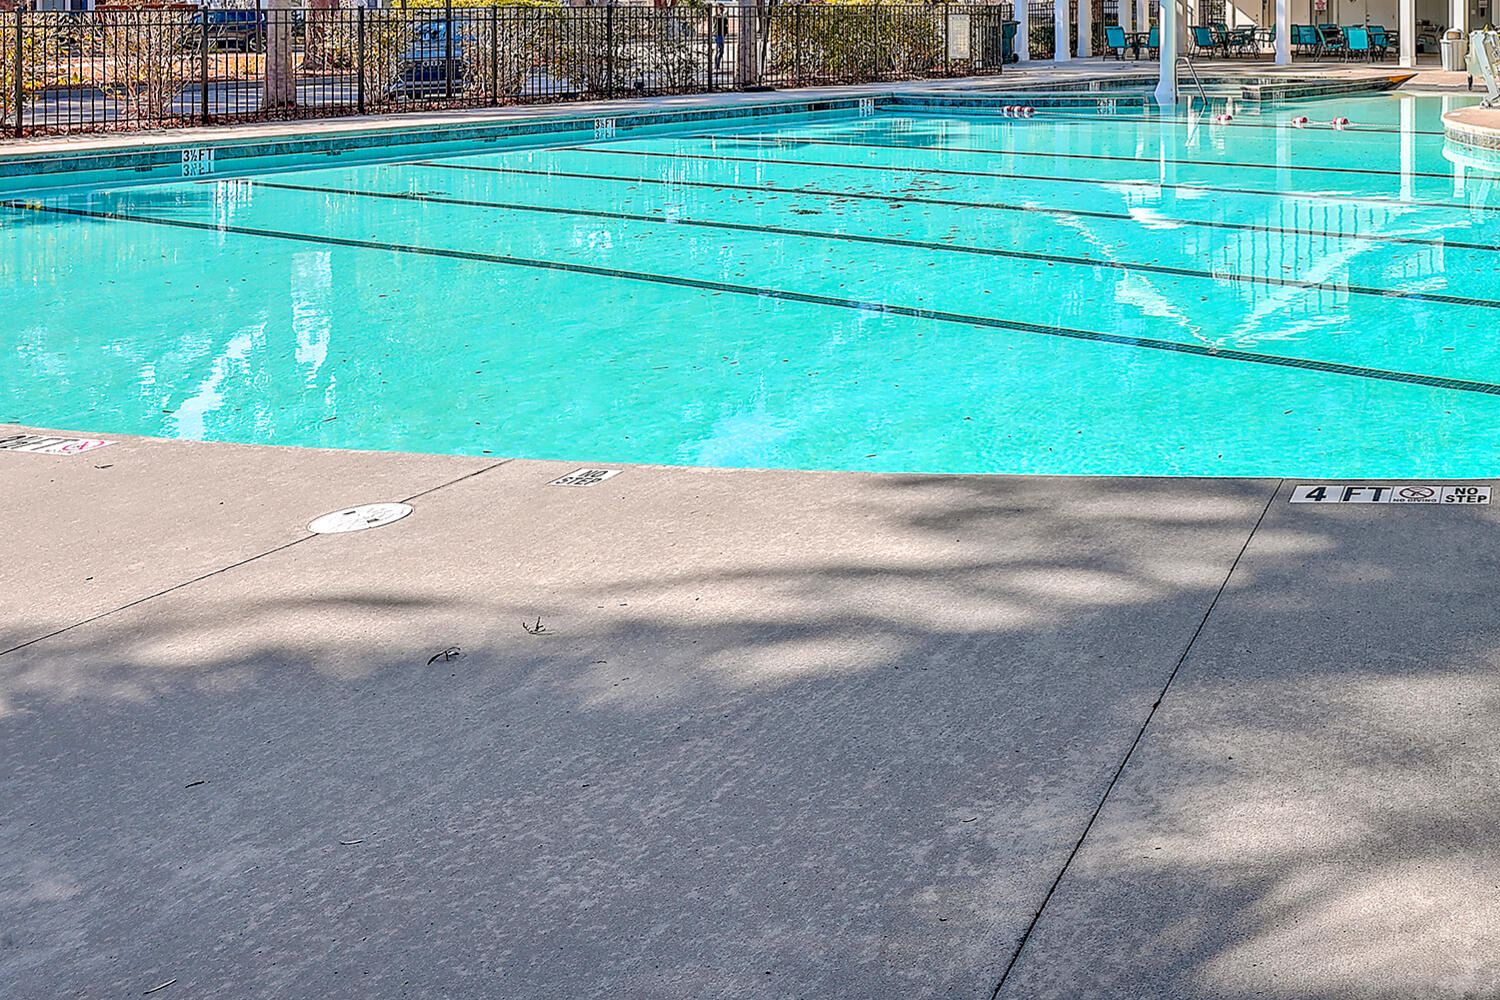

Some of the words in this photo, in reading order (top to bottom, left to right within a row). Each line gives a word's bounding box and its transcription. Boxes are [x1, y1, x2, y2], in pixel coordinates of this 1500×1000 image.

[579, 470, 608, 478] NO
[556, 477, 602, 486] STEP
[1305, 487, 1327, 502] 4
[1343, 487, 1391, 502] FT
[1455, 487, 1478, 495] NO
[1445, 495, 1488, 503] STEP
